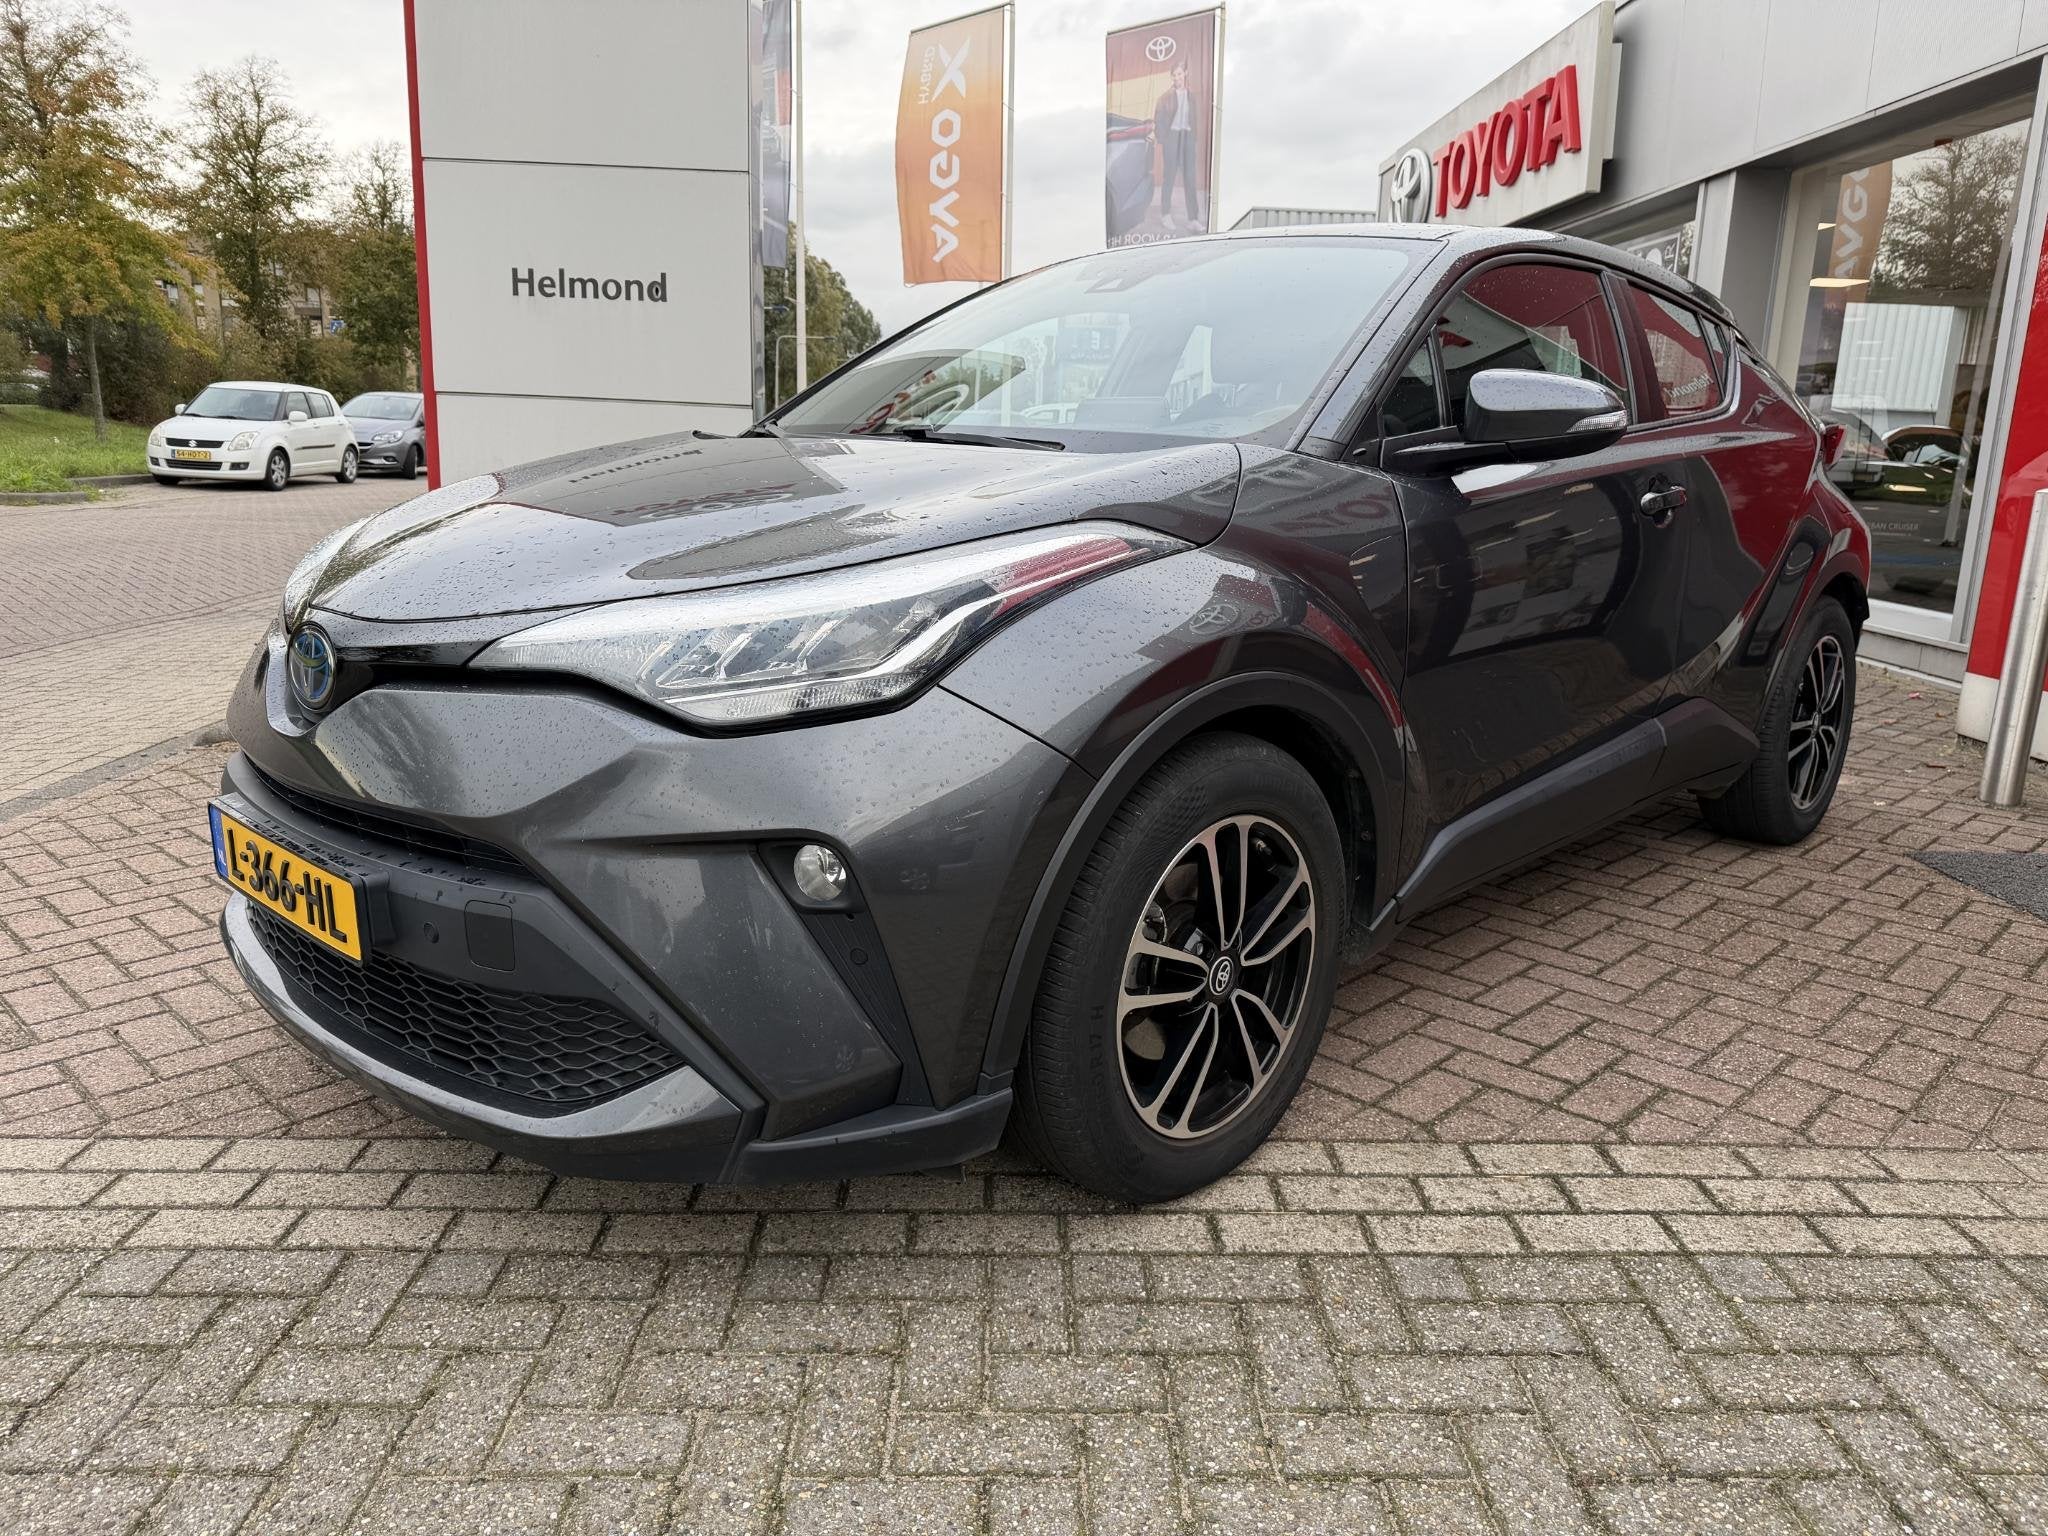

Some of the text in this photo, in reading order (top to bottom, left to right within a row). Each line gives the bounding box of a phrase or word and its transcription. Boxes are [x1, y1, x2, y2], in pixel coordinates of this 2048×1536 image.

[1433, 64, 1582, 217] TOYOTA
[511, 267, 667, 302] Helmond
[1888, 521, 1919, 531] CRUISER
[226, 827, 347, 943] L-366-HL
